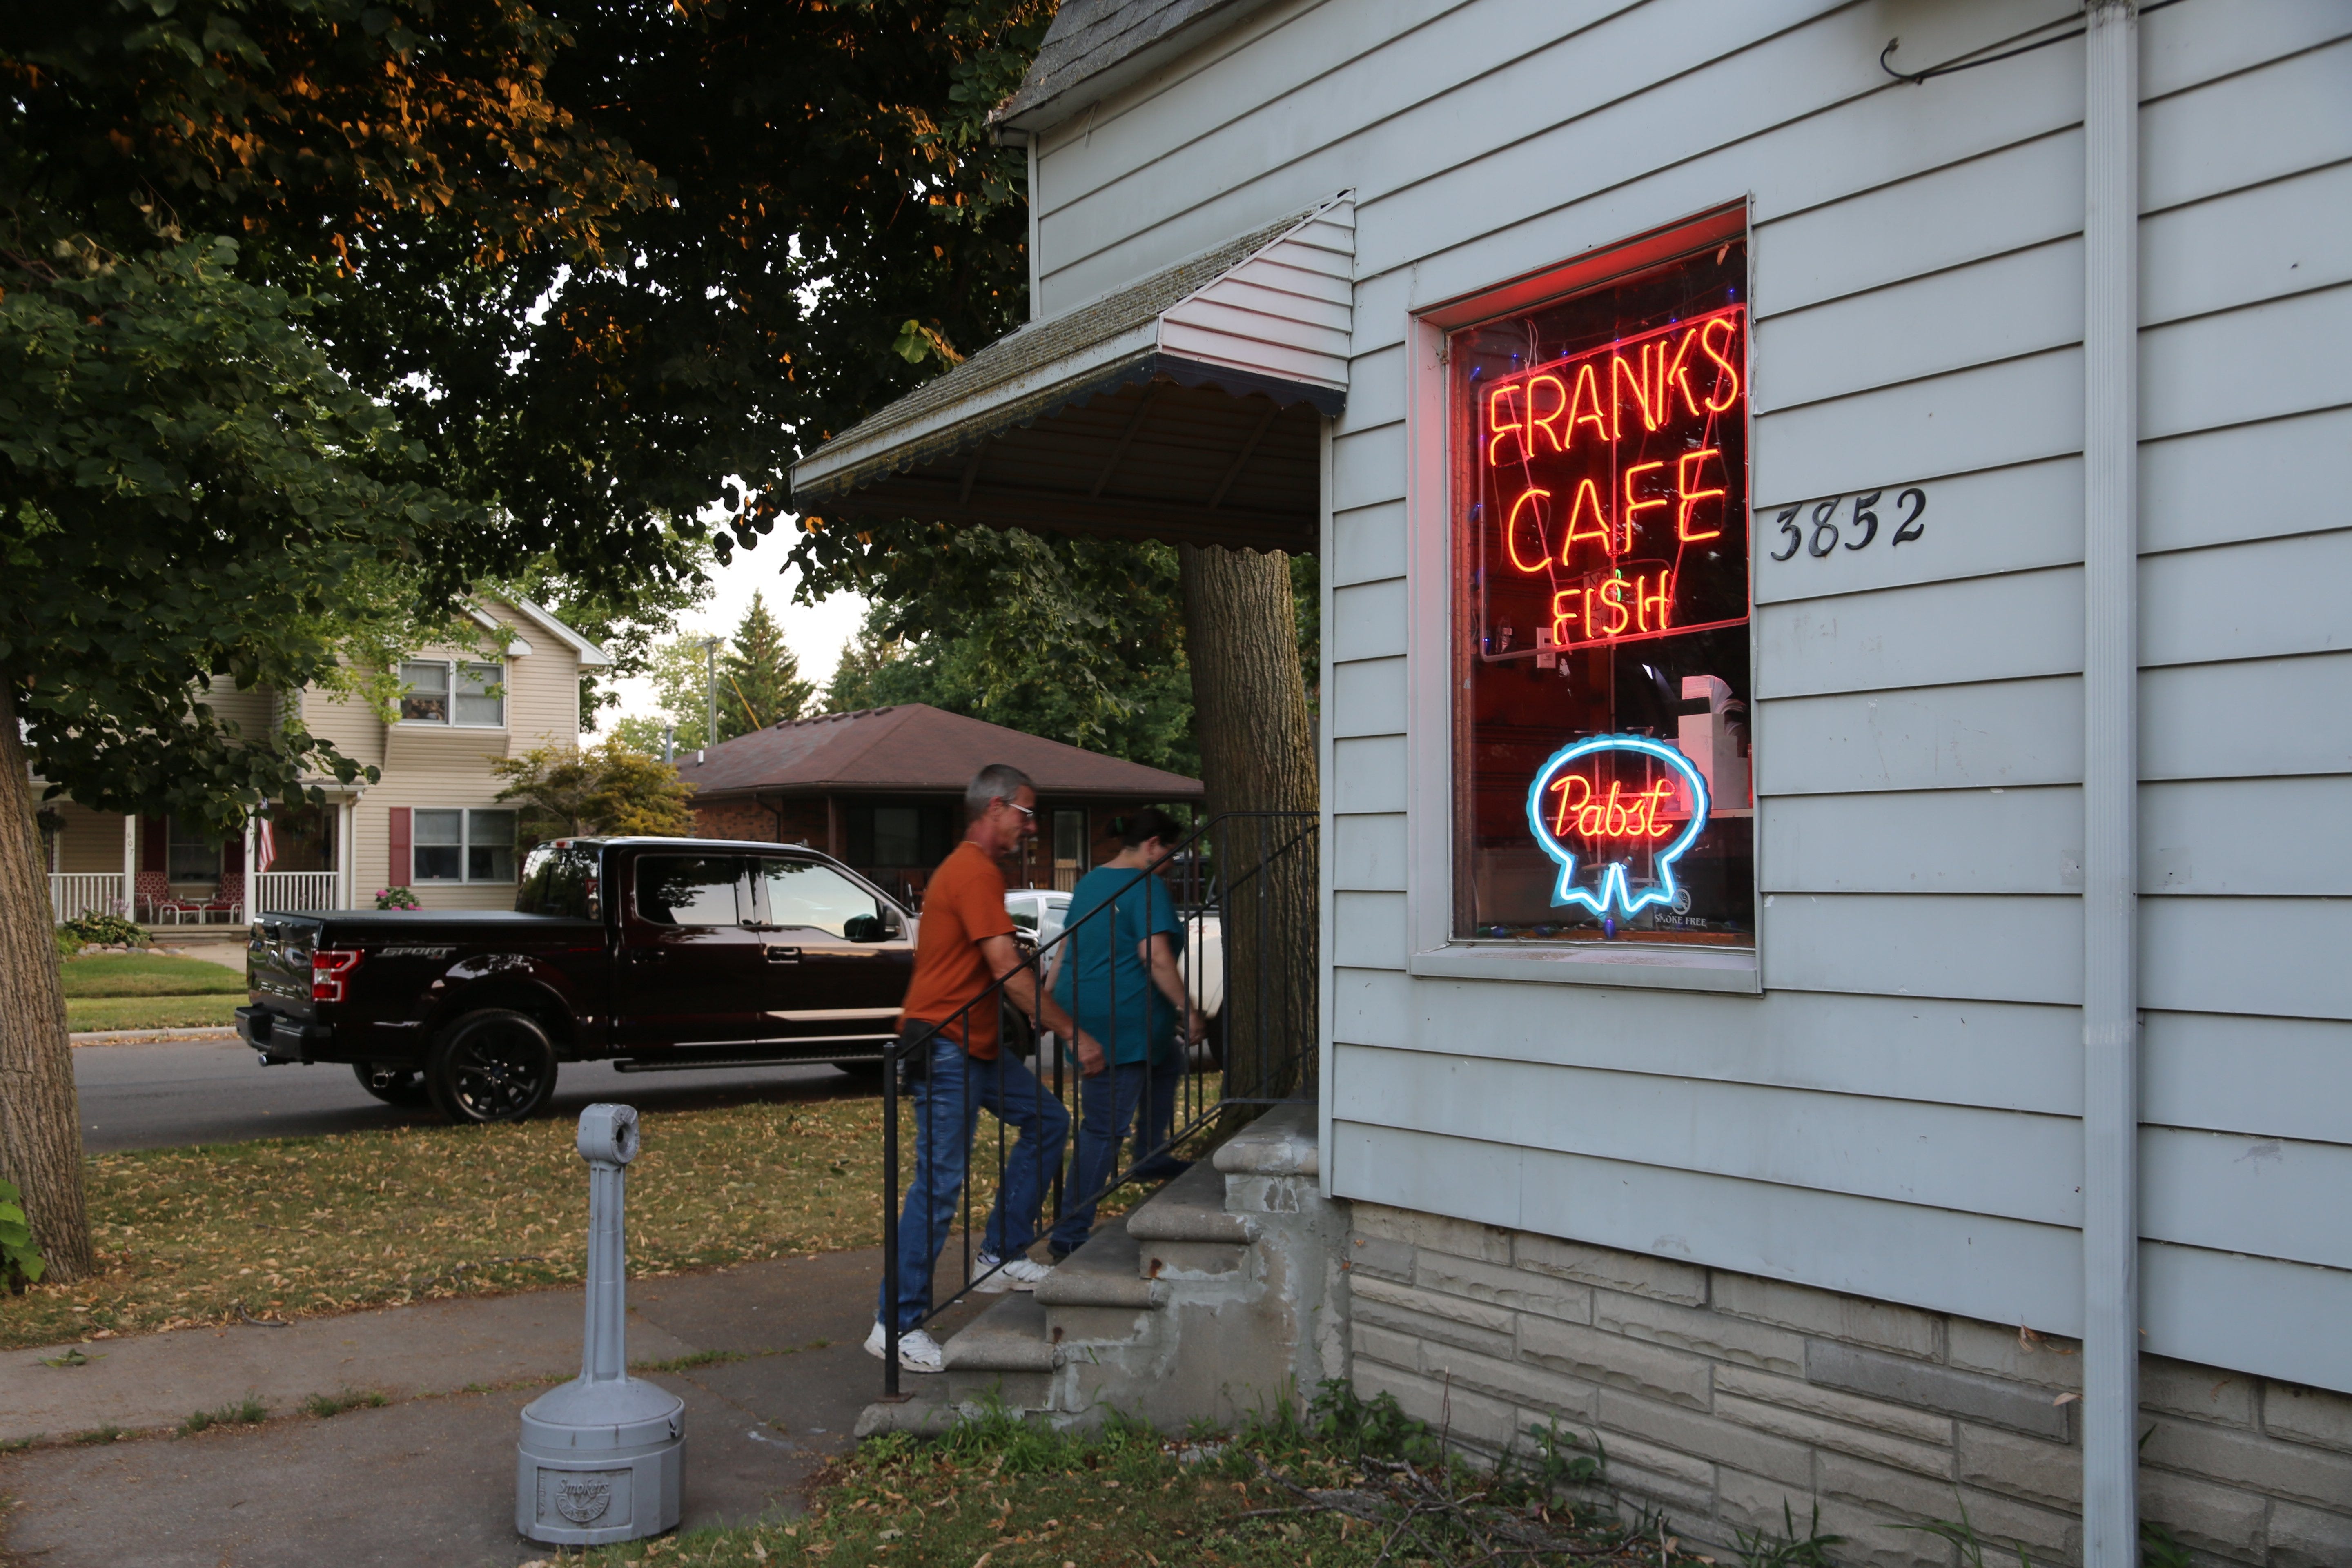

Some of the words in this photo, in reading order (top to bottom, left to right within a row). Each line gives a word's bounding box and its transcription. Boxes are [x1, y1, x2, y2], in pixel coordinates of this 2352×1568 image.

[1489, 318, 1739, 466] FRANKS
[1508, 449, 1724, 572] CAFE
[1771, 488, 1926, 561] 3852
[1553, 569, 1669, 646] FISH
[1550, 775, 1676, 837] Pabst
[374, 947, 456, 957] SPORT
[1655, 914, 1683, 924] SMOKE
[1686, 917, 1706, 926] FREE
